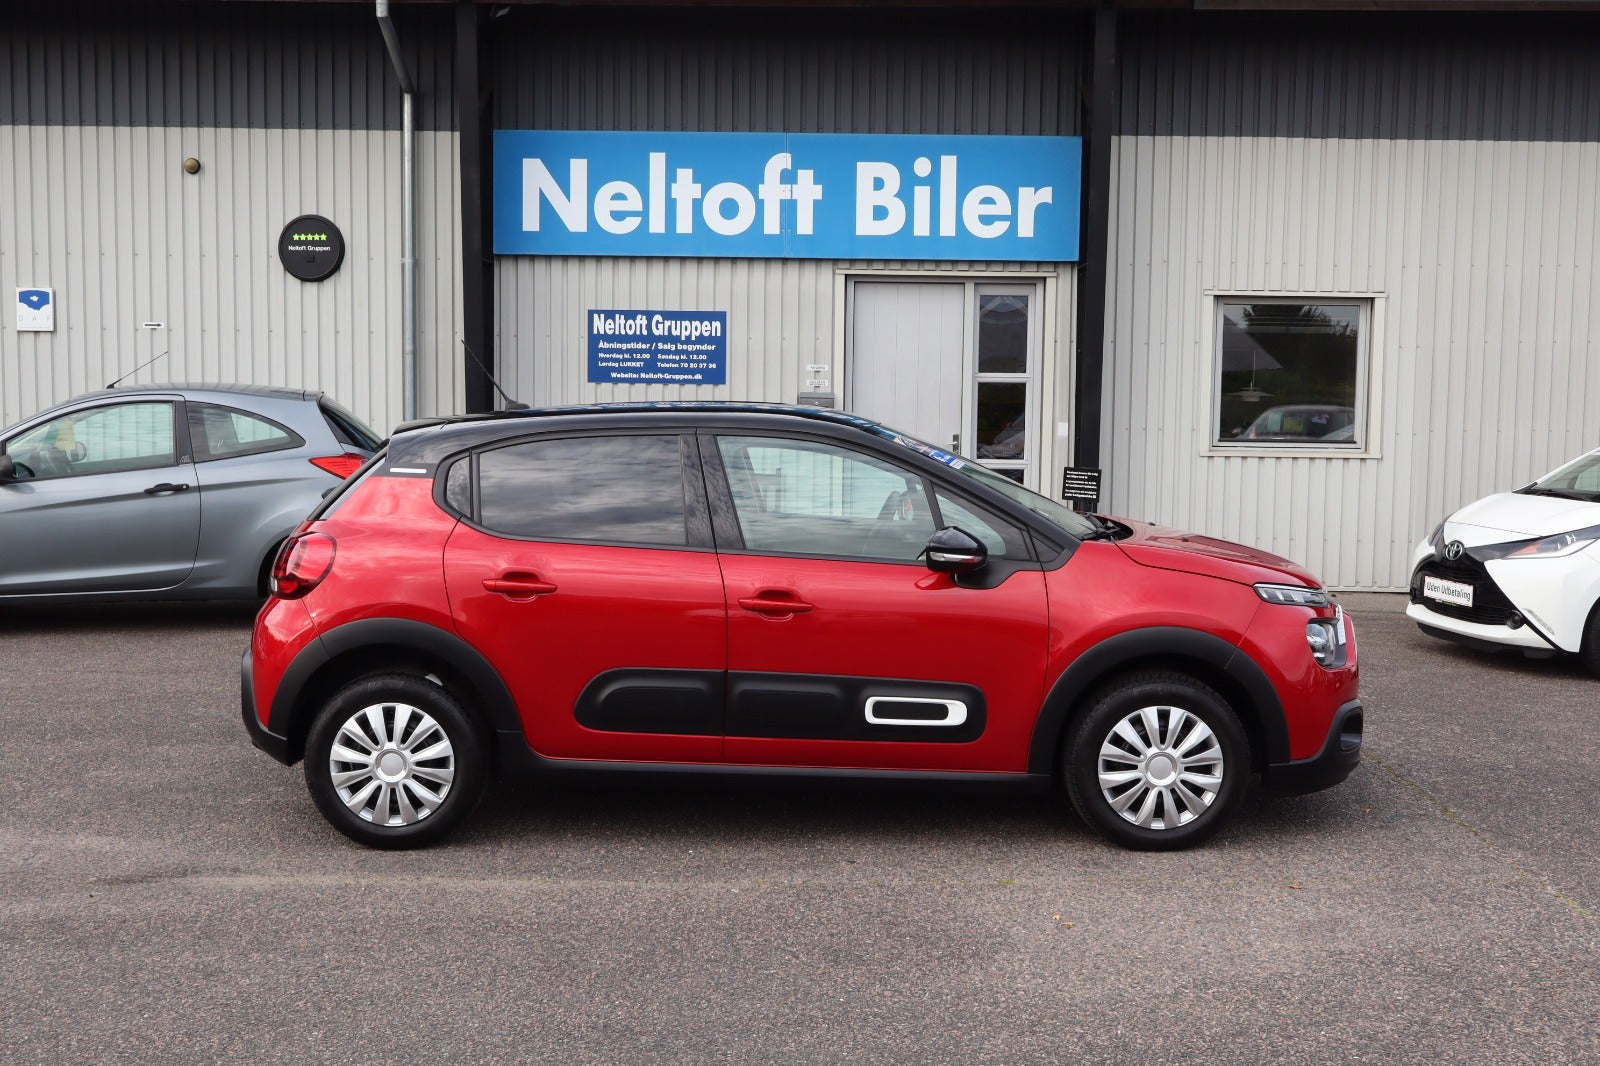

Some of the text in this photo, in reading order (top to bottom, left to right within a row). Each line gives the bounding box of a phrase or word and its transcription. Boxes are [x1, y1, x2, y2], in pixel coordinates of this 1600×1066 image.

[522, 151, 1052, 238] Neltoft Biler
[593, 313, 722, 341] Neltoft Gruppen
[598, 339, 651, 350] Åbningstider
[657, 342, 676, 351] Salg
[677, 343, 717, 352] begynder
[610, 371, 703, 381] Website: Neltoft-Gruppen.dk
[1426, 581, 1441, 592] Uden
